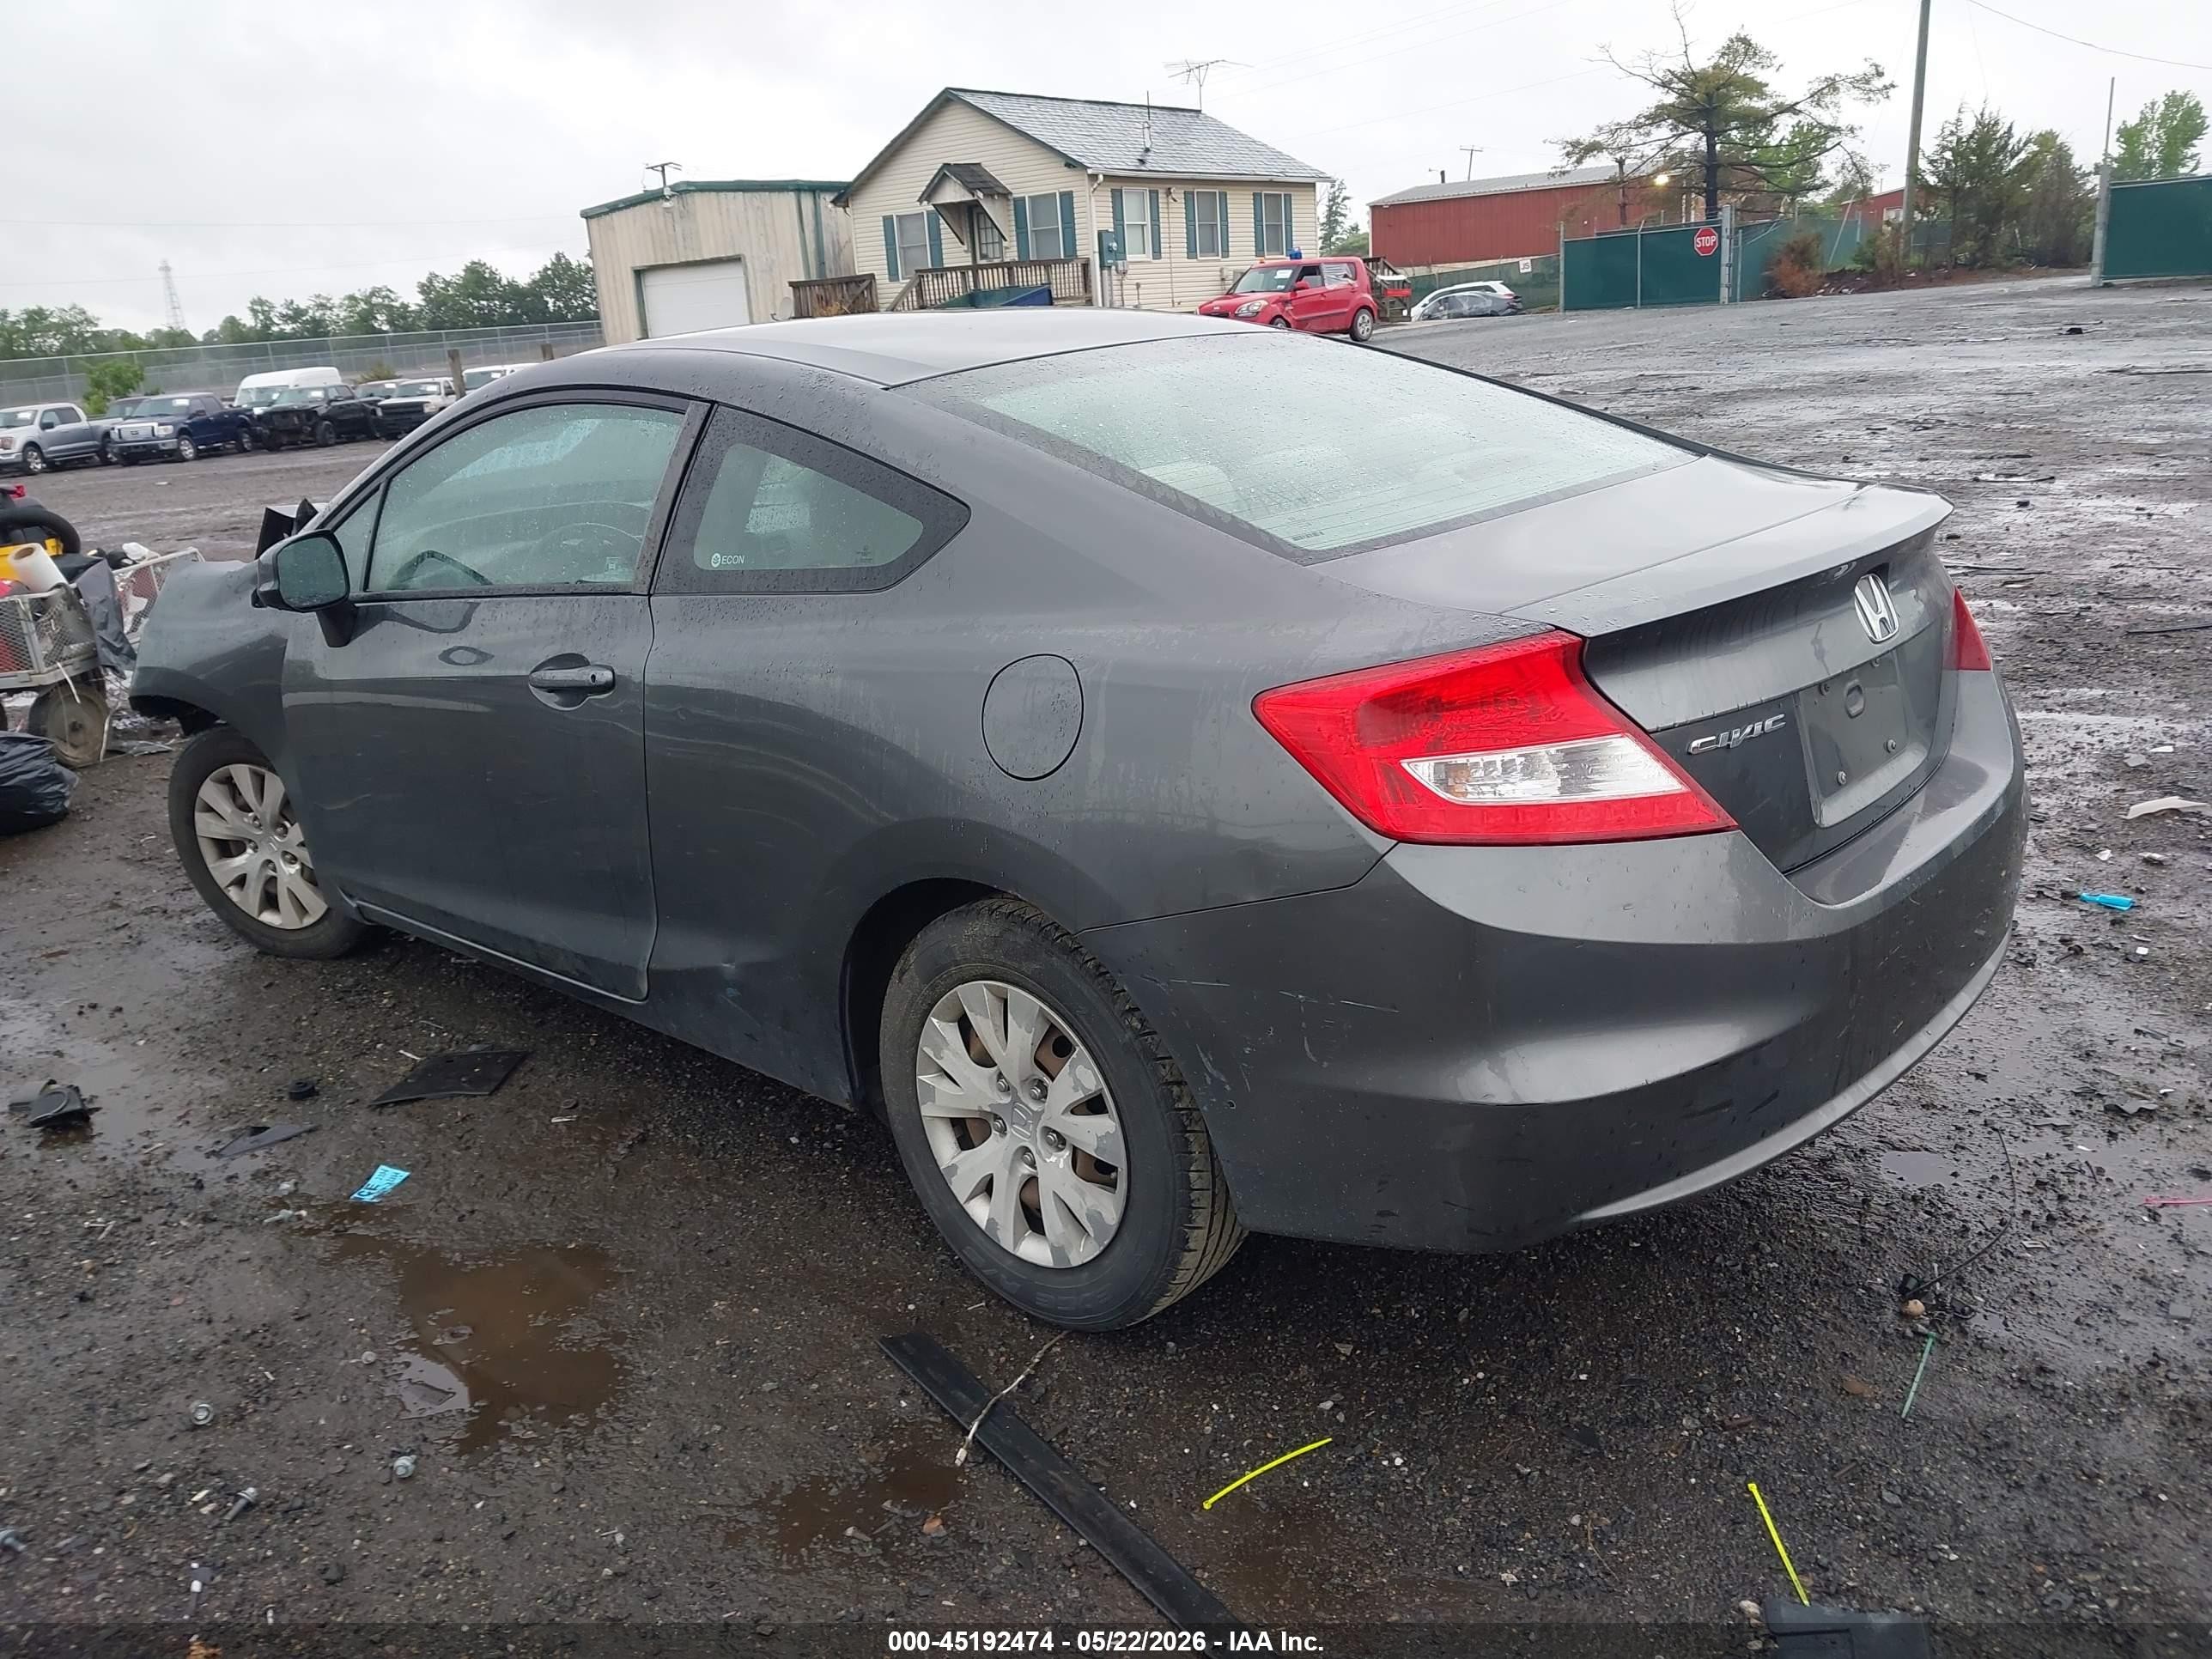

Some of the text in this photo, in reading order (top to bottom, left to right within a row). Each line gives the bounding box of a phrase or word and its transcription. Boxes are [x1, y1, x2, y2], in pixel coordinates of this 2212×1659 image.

[1696, 235, 1717, 248] STOP
[721, 555, 744, 565] ECON
[1689, 714, 1786, 755] CIVIC
